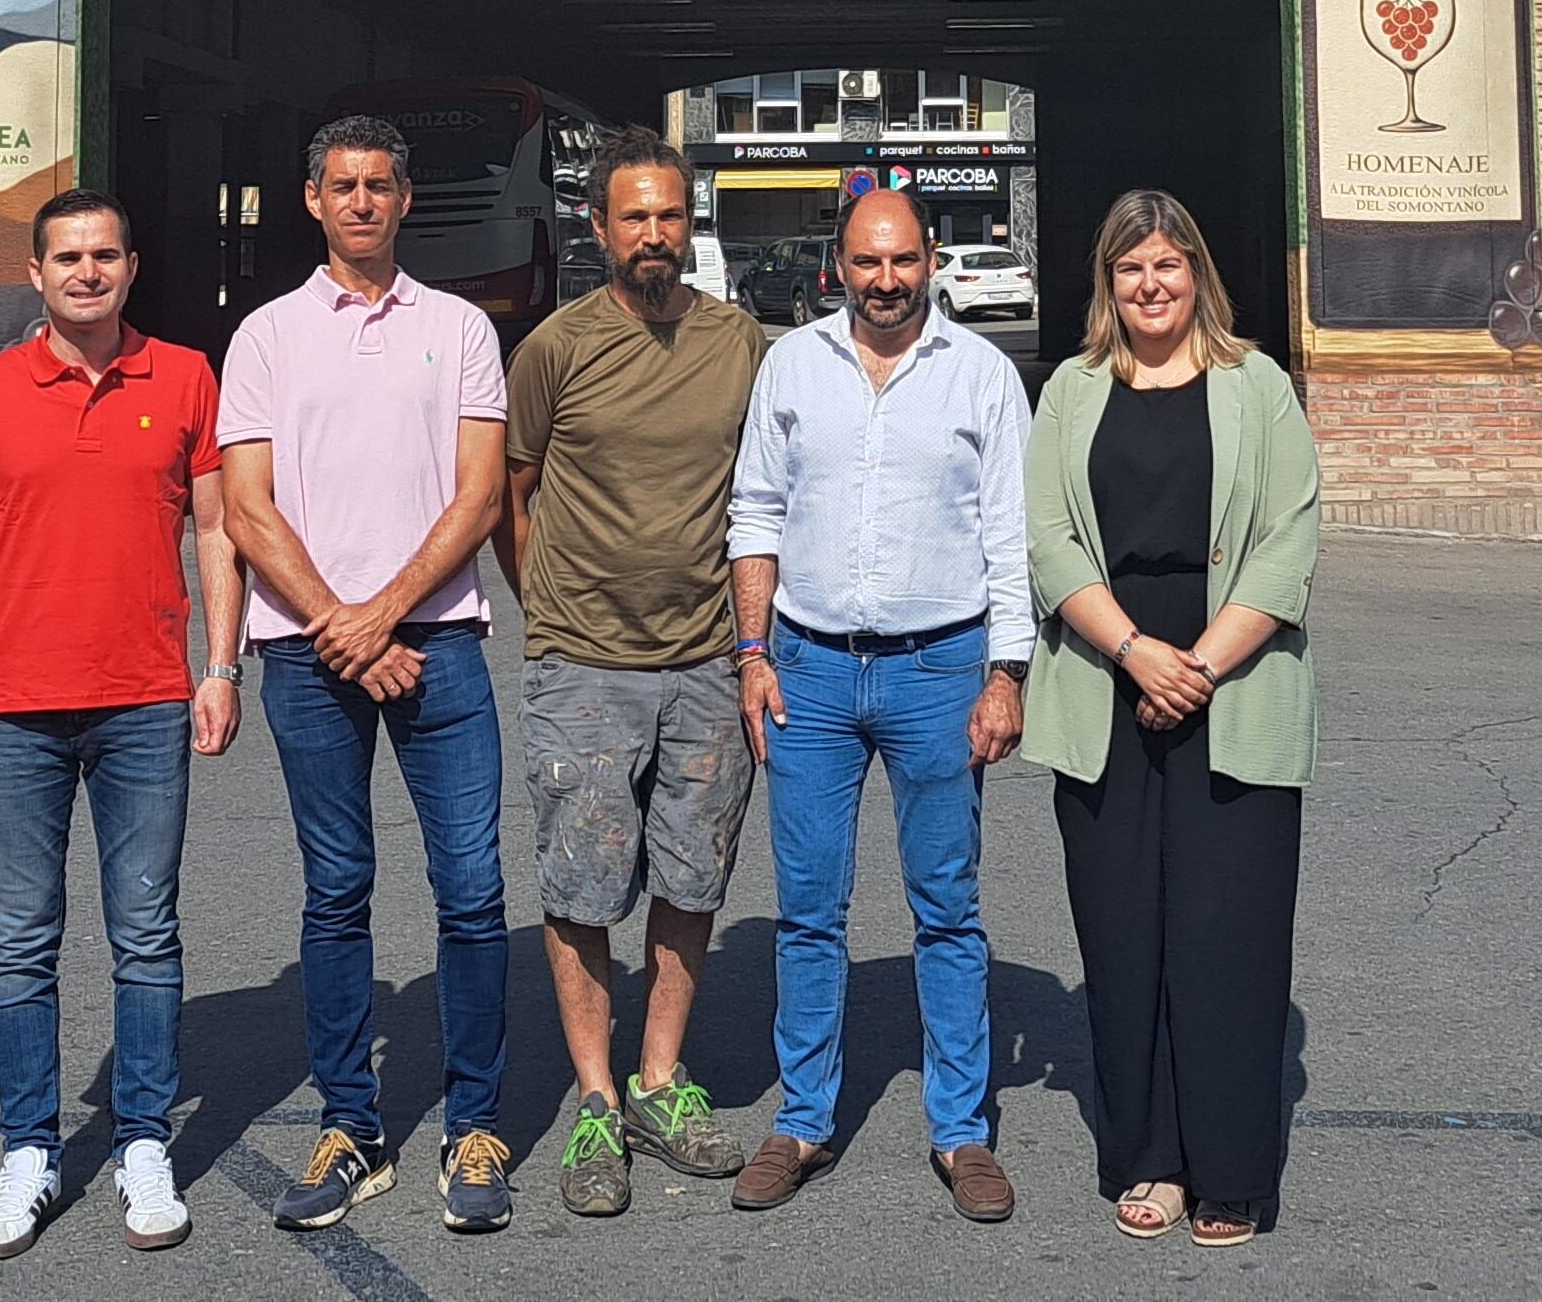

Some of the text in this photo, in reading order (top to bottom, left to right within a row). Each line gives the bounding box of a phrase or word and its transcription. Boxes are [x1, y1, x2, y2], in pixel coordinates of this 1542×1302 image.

[747, 146, 808, 159] PARCOBA
[879, 143, 1026, 157] parquet cocinas baños
[1346, 153, 1490, 174] HOMENAJE
[916, 167, 999, 184] PARCOBA
[1330, 183, 1508, 198] A LA TRADICIÓN VINÍCOLA
[515, 206, 542, 218] 8557
[1356, 199, 1485, 213] DEL SOMONTANO
